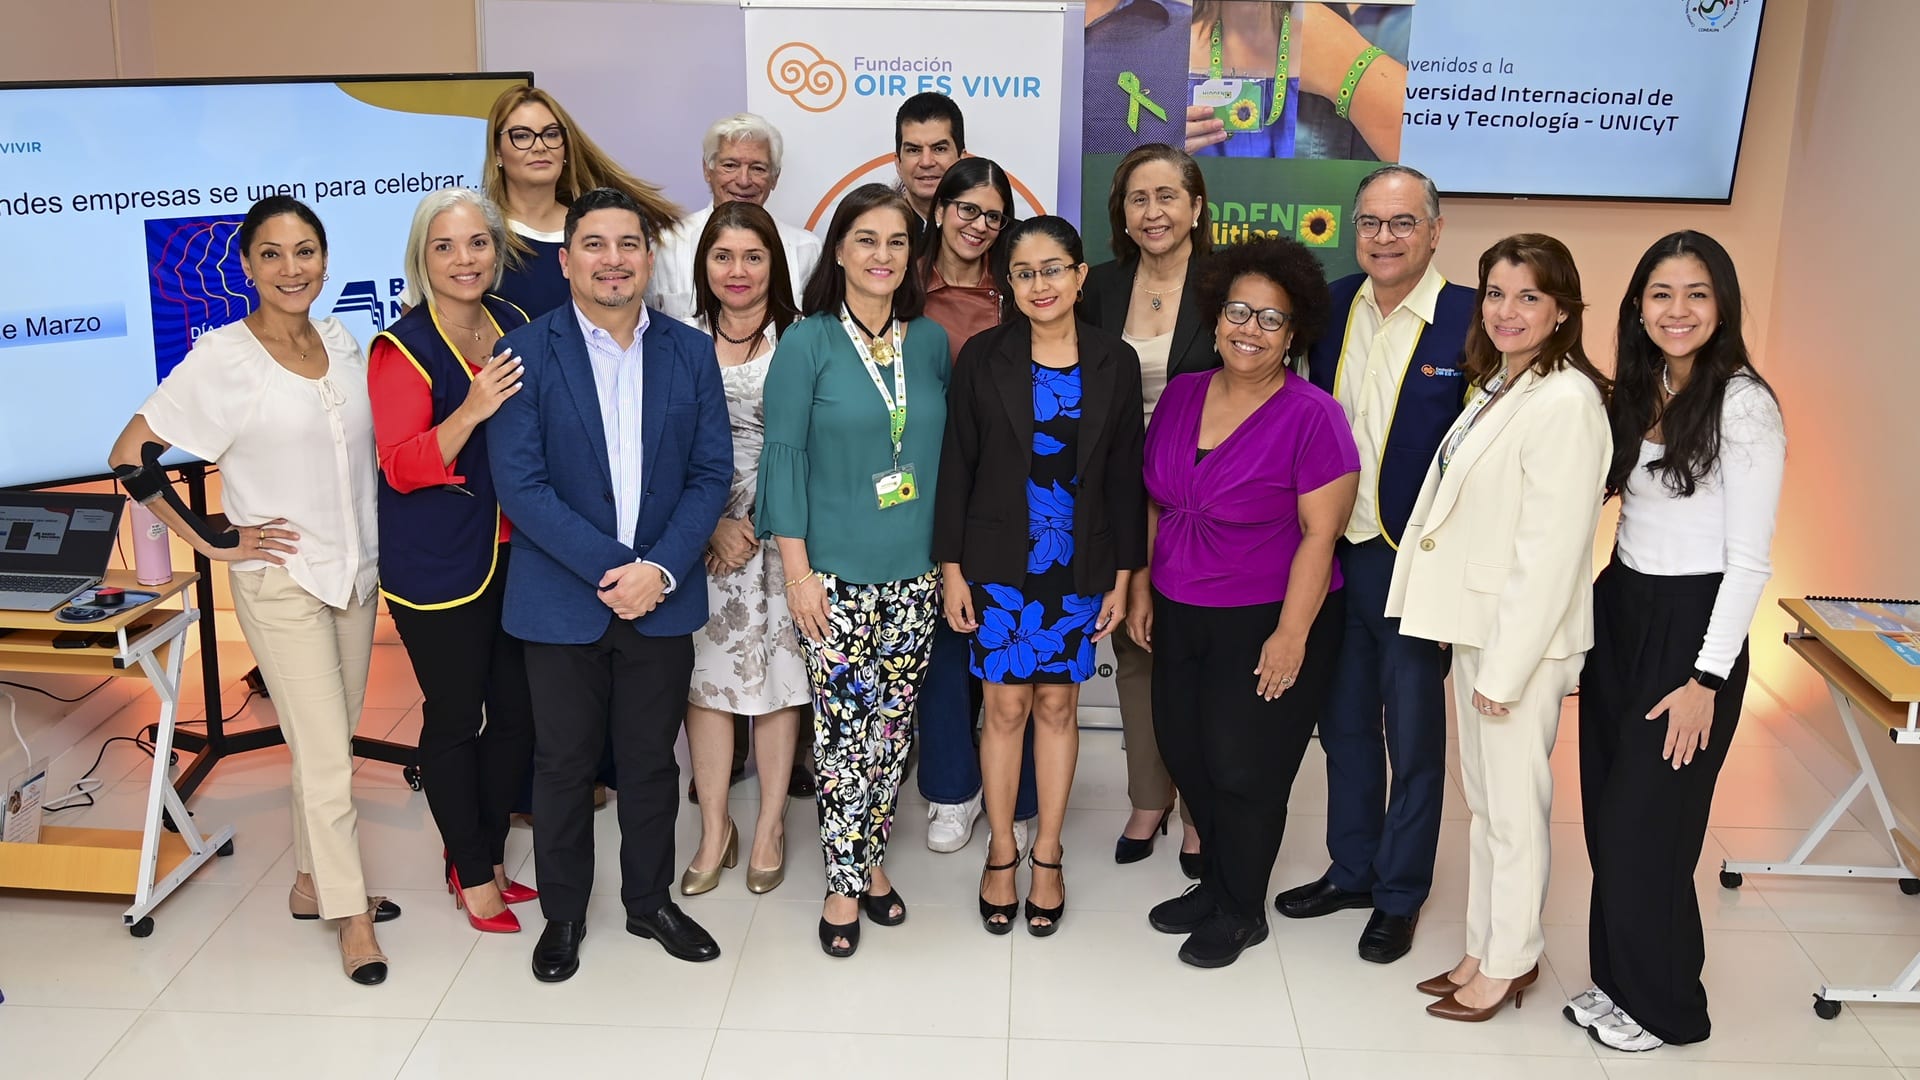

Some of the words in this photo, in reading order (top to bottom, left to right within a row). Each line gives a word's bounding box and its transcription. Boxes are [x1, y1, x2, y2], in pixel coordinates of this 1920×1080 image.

[854, 56, 953, 72] Fundación
[1406, 56, 1478, 73] venidos
[1482, 61, 1492, 74] a
[1499, 57, 1514, 74] la
[854, 75, 906, 97] OIR
[917, 75, 952, 96] ES
[962, 76, 1041, 98] VIVIR
[1405, 84, 1497, 102] versidad
[1501, 86, 1643, 106] Internacional
[1647, 88, 1674, 106] de
[1447, 113, 1460, 131] y
[1464, 111, 1580, 134] Tecnología
[1600, 114, 1680, 136] UNICyT
[0, 141, 42, 154] VIVIR
[72, 189, 200, 215] empresas
[209, 186, 238, 204] se
[247, 182, 307, 201] unen
[315, 180, 366, 203] para
[0, 323, 17, 340] e
[25, 316, 101, 337] Marzo
